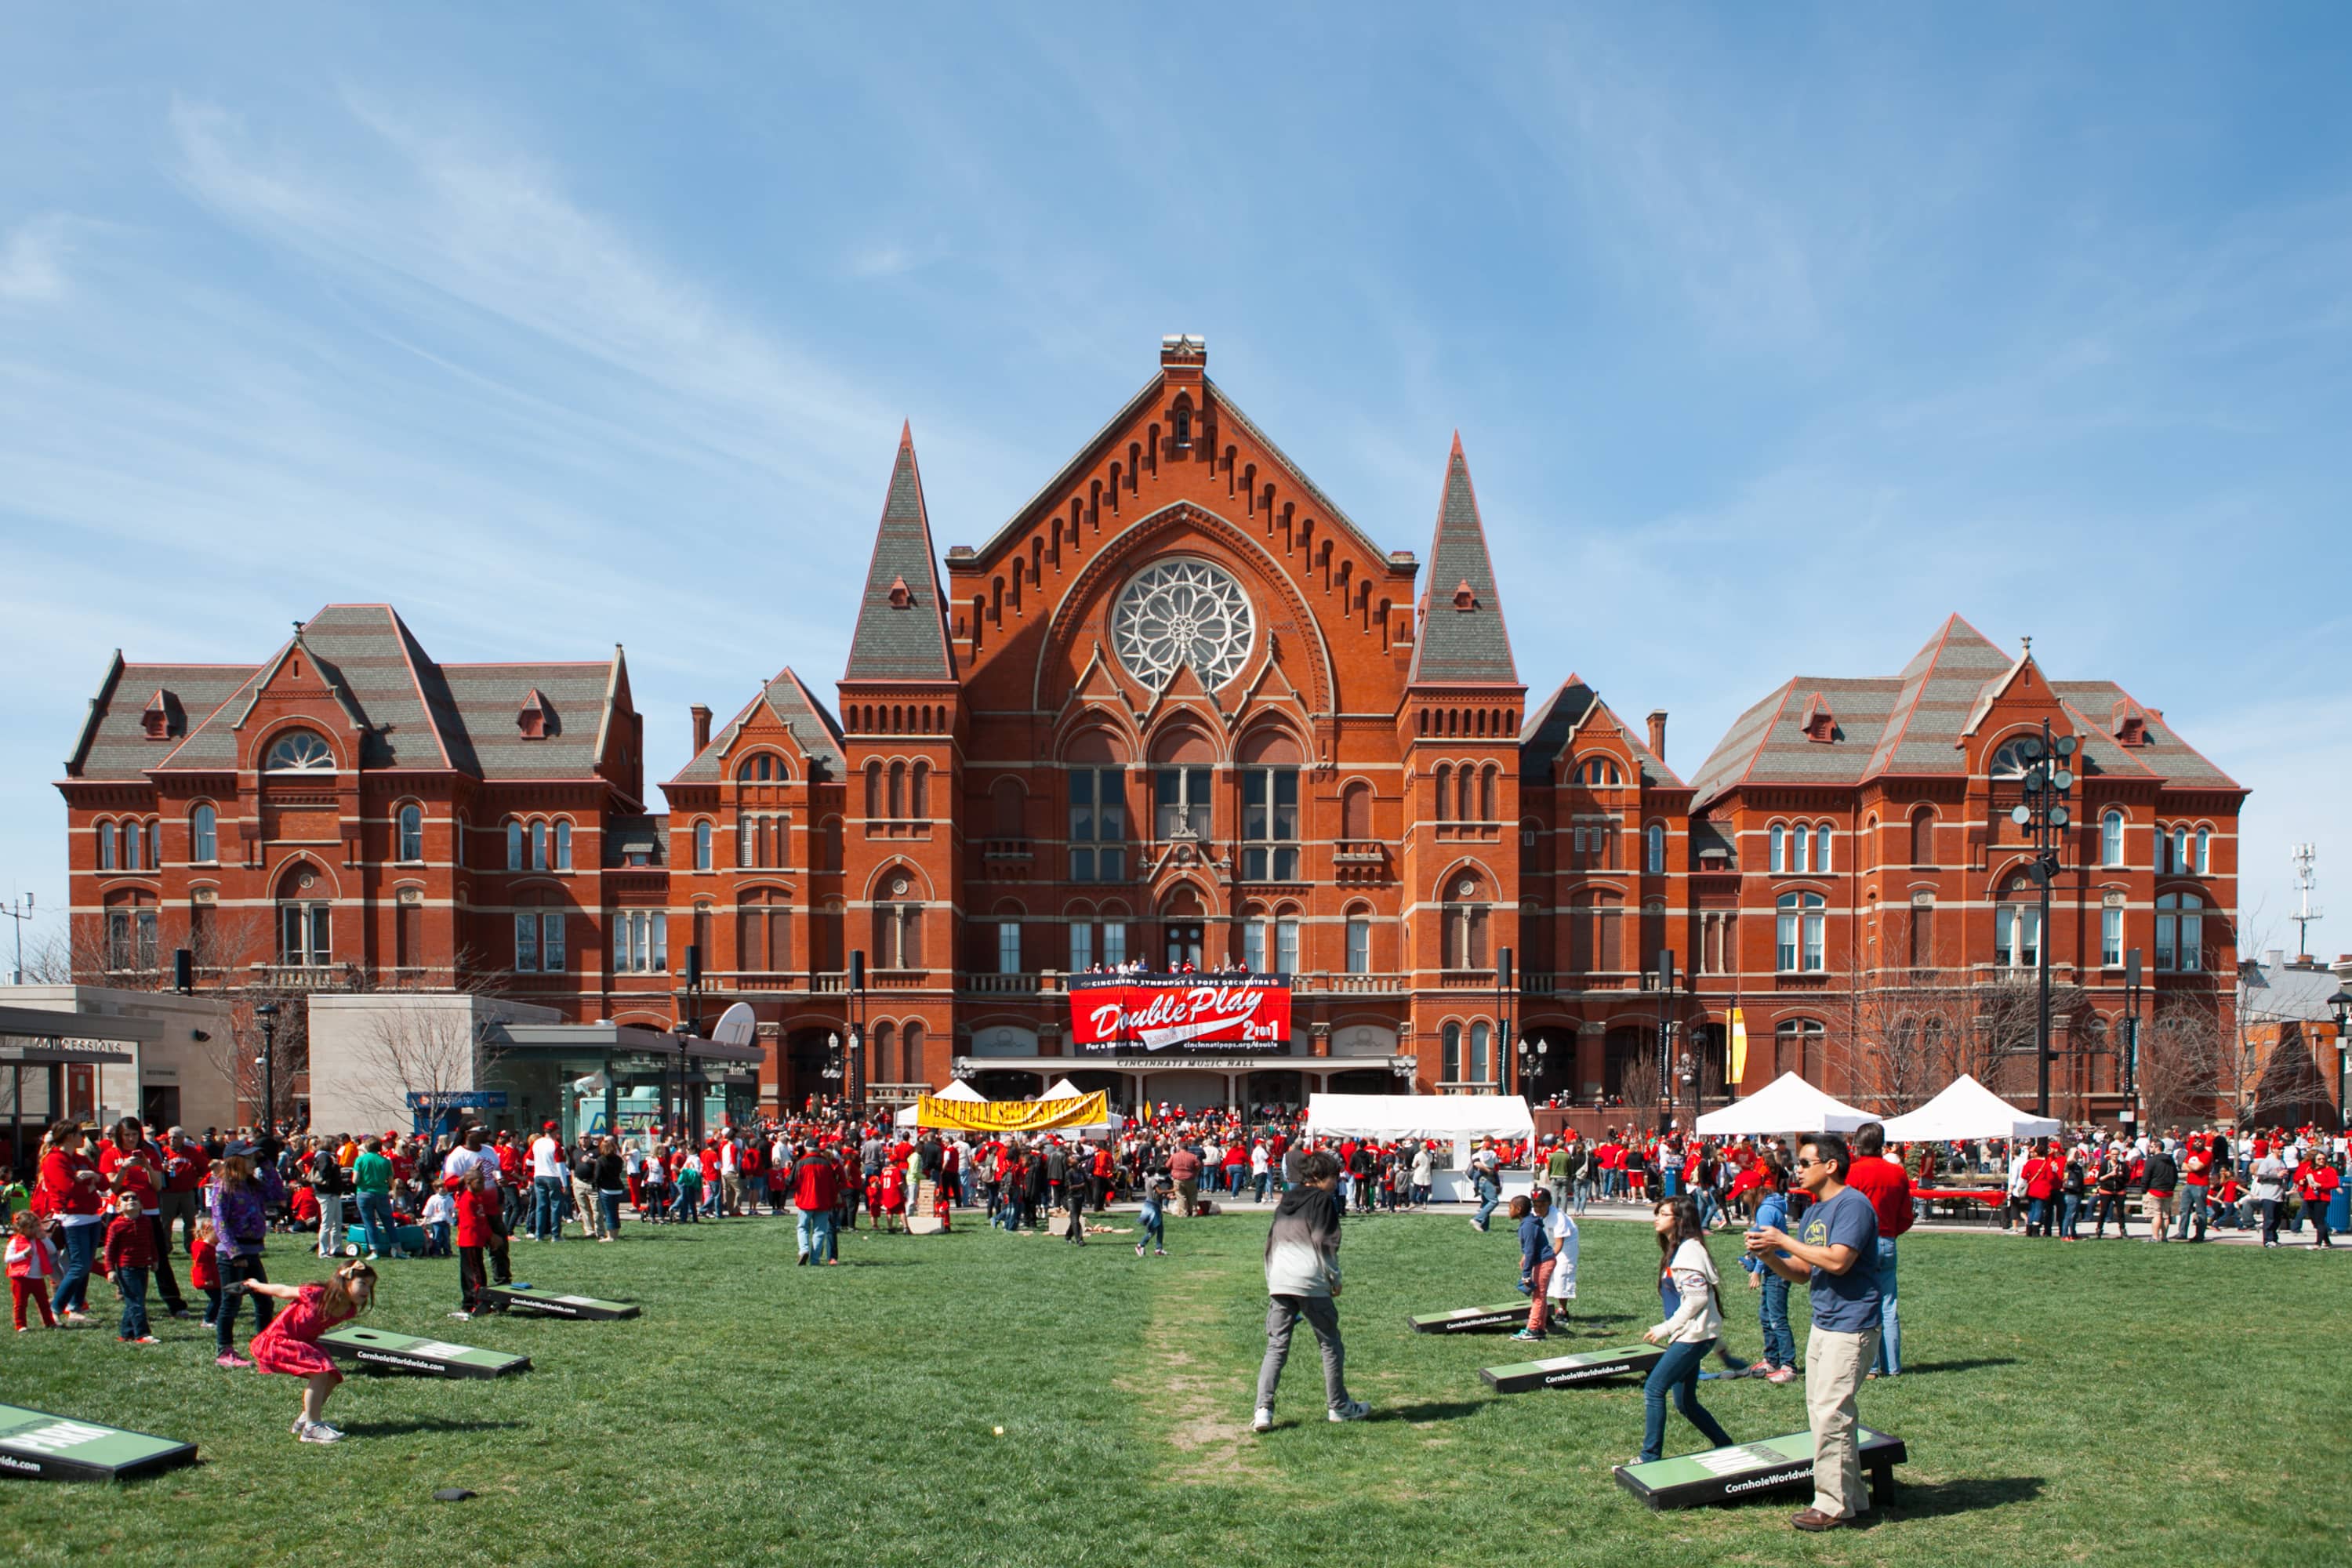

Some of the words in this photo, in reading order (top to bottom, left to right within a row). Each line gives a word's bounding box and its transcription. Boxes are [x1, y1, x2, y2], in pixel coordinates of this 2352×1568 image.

[1090, 993, 1188, 1038] Double
[1186, 986, 1264, 1022] Play
[358, 1350, 445, 1372] CornholeWorldwide.com
[1545, 1364, 1630, 1384] CornholeWorldwide.com
